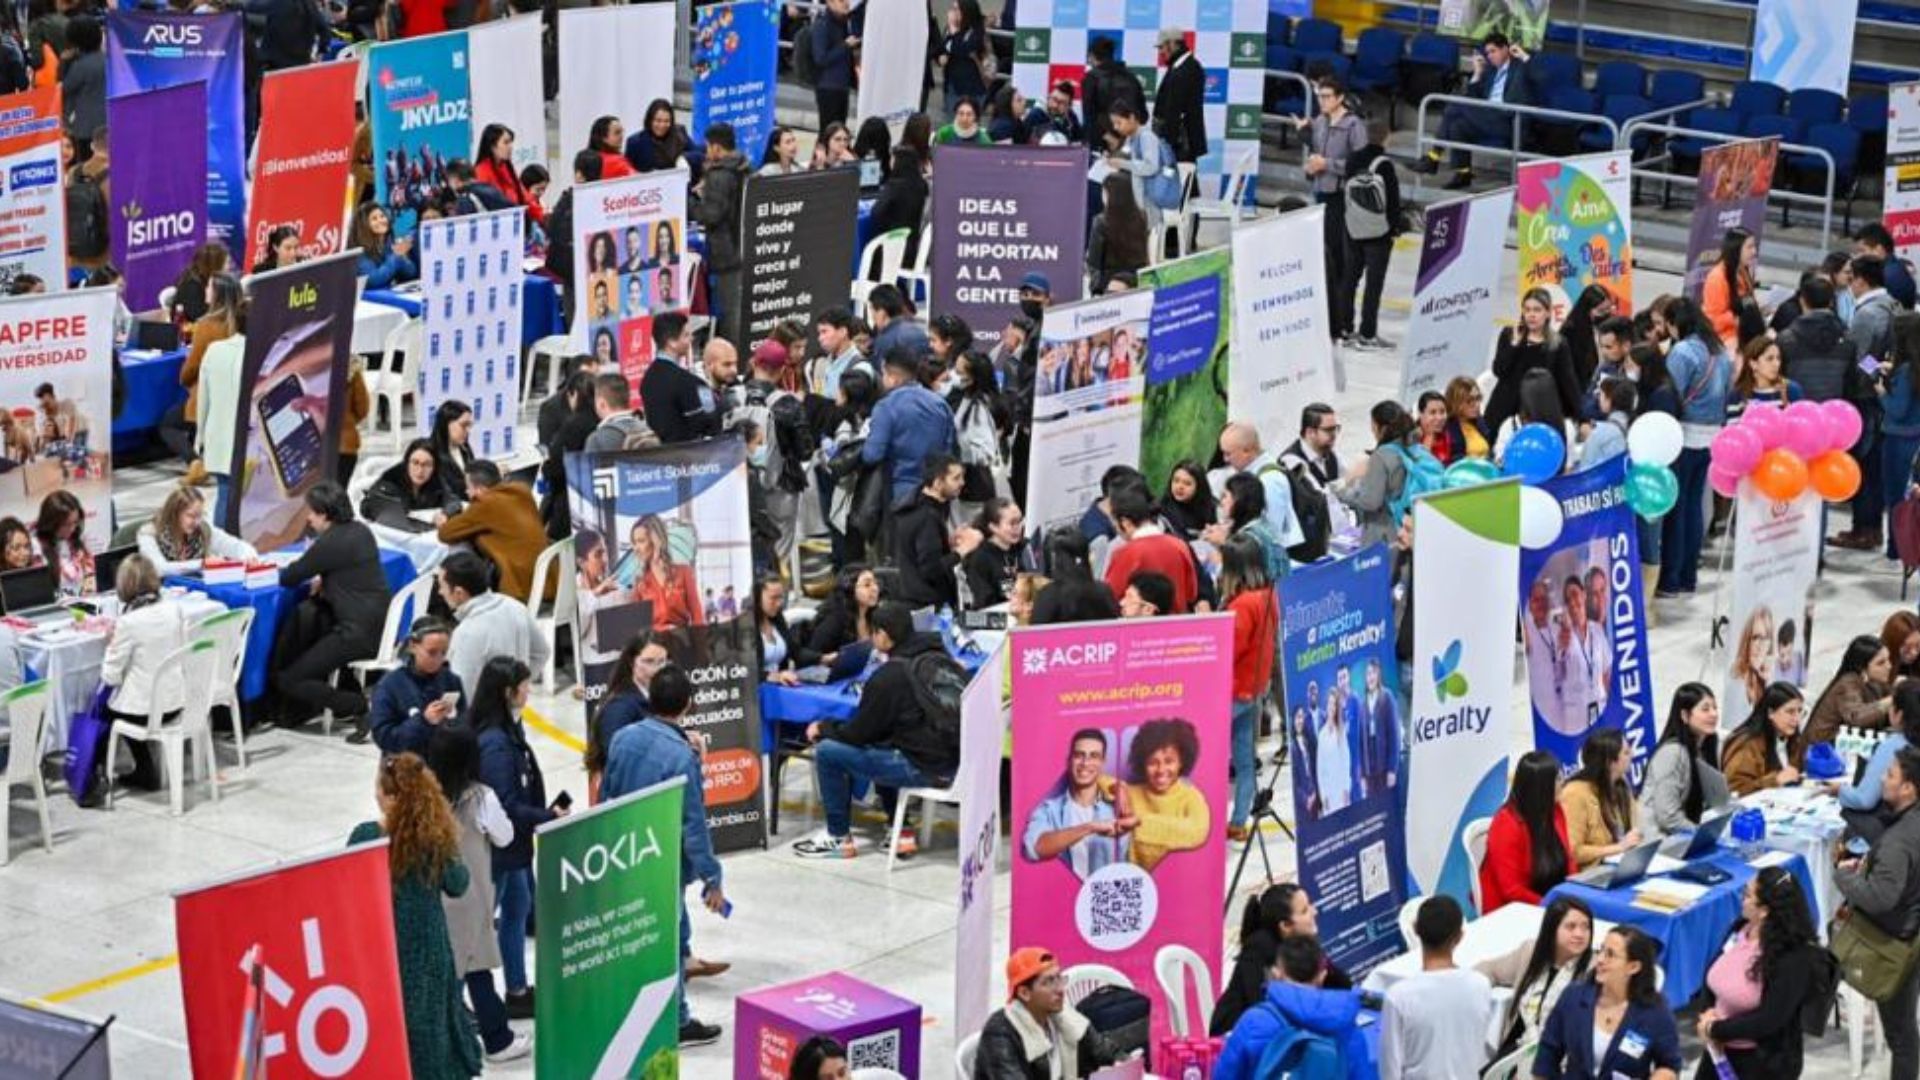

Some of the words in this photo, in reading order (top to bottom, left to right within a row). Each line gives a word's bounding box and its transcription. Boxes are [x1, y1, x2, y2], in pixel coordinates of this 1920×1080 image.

[143, 24, 204, 44] ARUS
[757, 203, 770, 217] El
[770, 199, 804, 219] lugar
[958, 198, 1018, 215] IDEAS
[756, 221, 795, 237] donde
[957, 220, 1001, 237] QUE
[1003, 221, 1028, 237] LE
[1431, 218, 1449, 238] 45
[755, 240, 781, 255] vive
[782, 239, 792, 254] y
[957, 243, 1059, 261] IMPORTAN
[754, 260, 787, 276] crece
[788, 256, 801, 270] el
[956, 266, 971, 282] A
[976, 265, 1001, 282] LA
[753, 277, 788, 295] mejor
[955, 286, 1021, 304] GENTE
[752, 297, 794, 314] talento
[796, 292, 813, 305] de
[0, 315, 87, 345] APFRE
[624, 467, 661, 485] Talent
[663, 462, 721, 479] Solutions
[1307, 626, 1317, 645] a
[1318, 609, 1362, 641] nuestro
[1050, 642, 1117, 666] ACRIP
[1296, 642, 1337, 672] talento
[1338, 617, 1386, 655] Keralty!
[1612, 532, 1648, 787] ENVENIDOS
[730, 663, 748, 679] de
[694, 688, 728, 705] debe
[730, 687, 740, 700] a
[1057, 681, 1184, 705] www.acrip.org
[1413, 705, 1492, 744] Keralty
[705, 811, 760, 829] olombia.co
[561, 826, 662, 893] NOKIA
[562, 964, 577, 979] the
